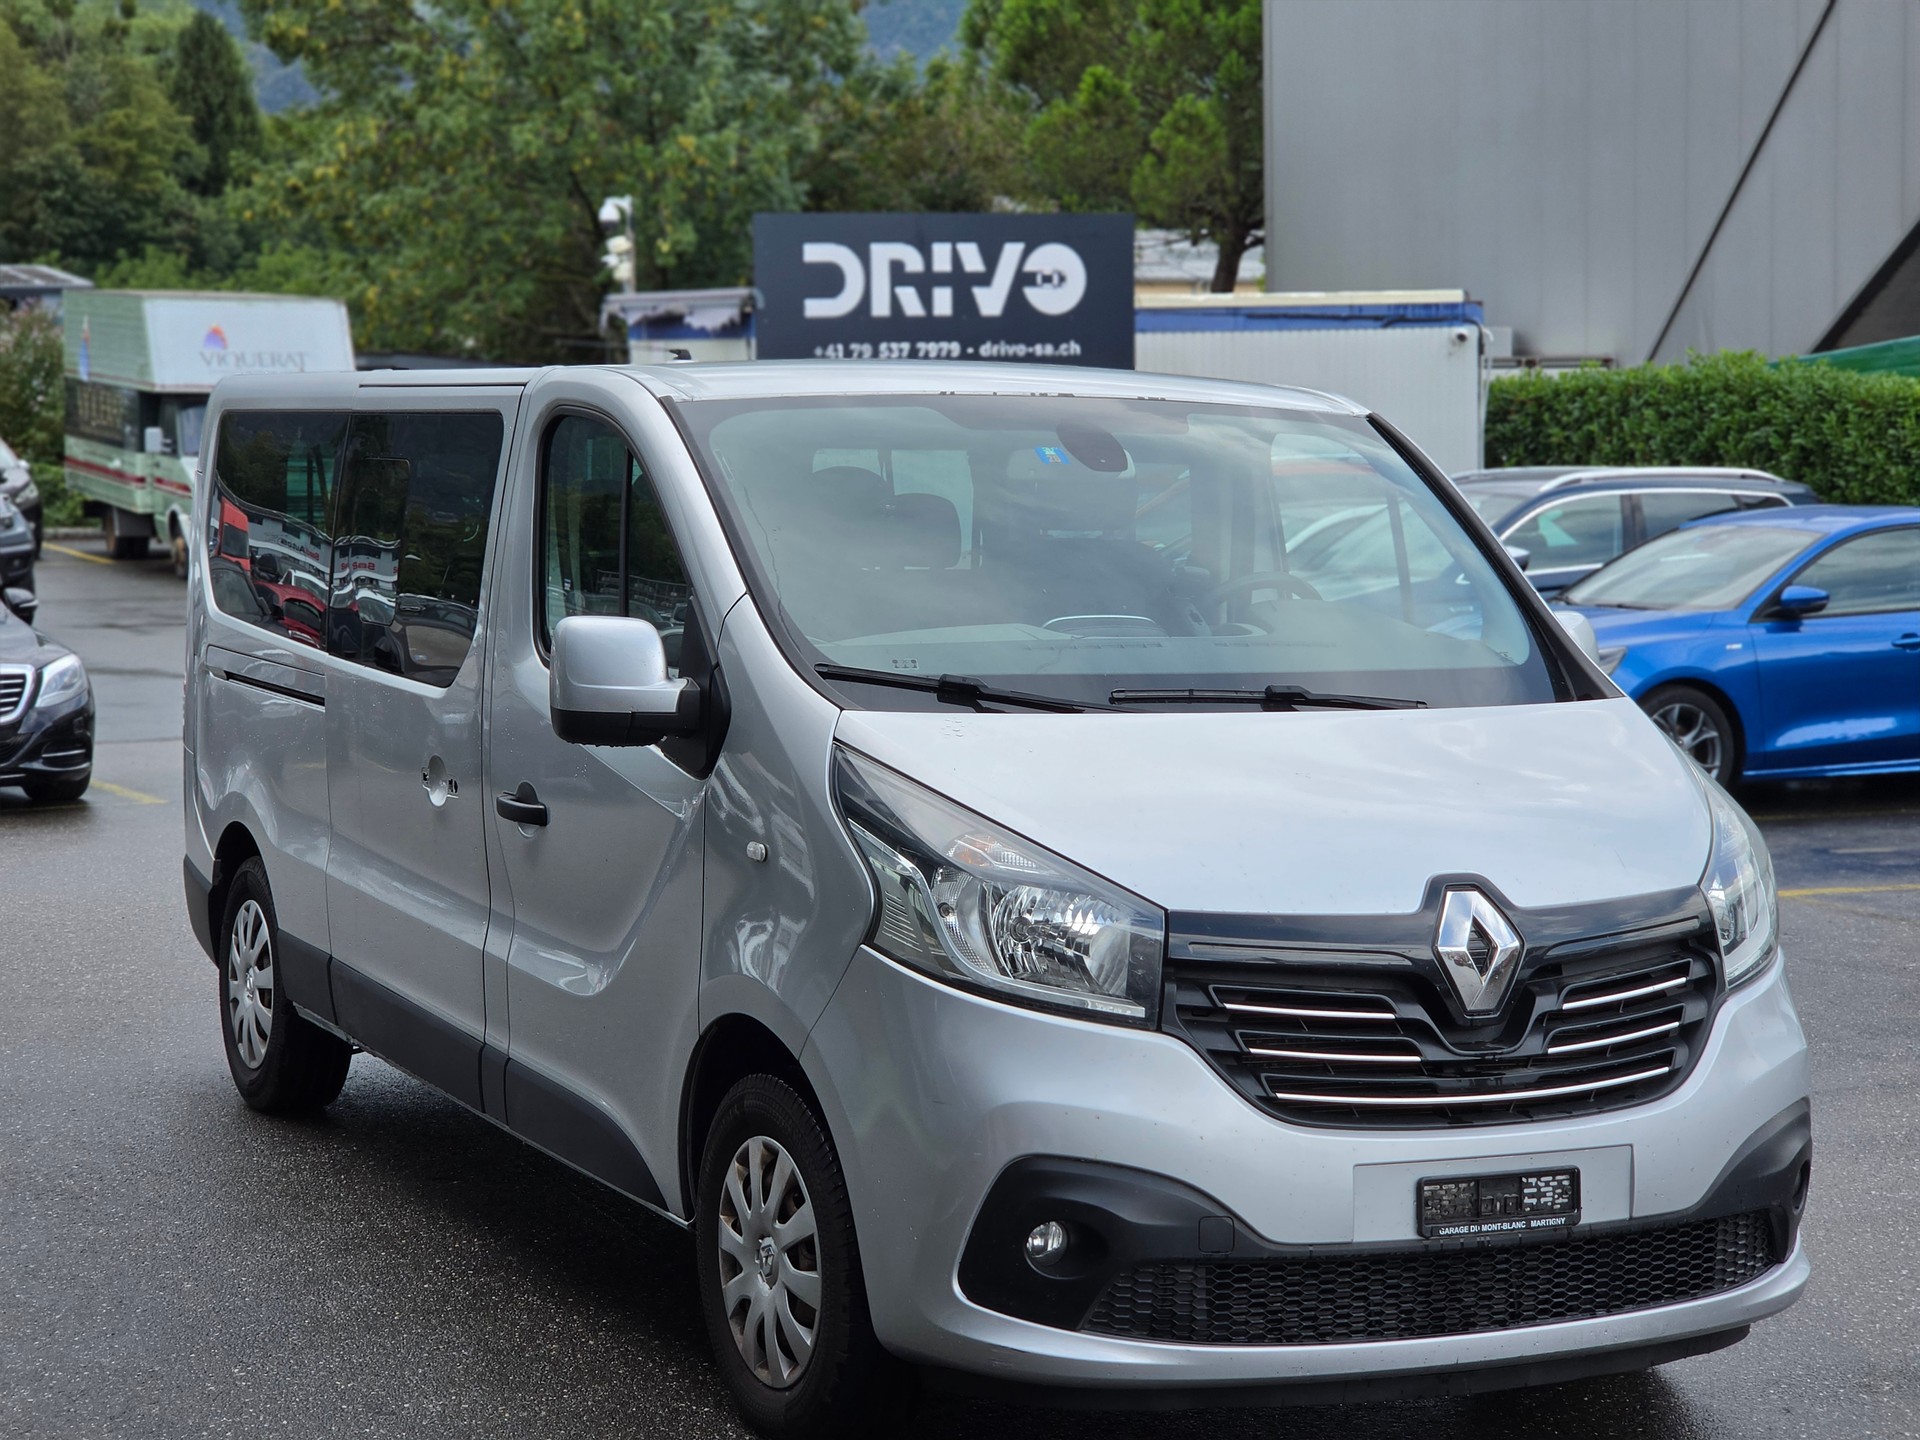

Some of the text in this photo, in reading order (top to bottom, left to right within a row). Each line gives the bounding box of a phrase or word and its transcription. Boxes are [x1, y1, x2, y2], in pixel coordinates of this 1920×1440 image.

[803, 242, 1087, 318] DRIVO
[814, 340, 1082, 359] +41 79 537 7979 drivo-sa.ch
[1439, 1226, 1469, 1235] GARAGE
[1481, 1220, 1526, 1232] MONT-BLANC
[1530, 1217, 1566, 1228] MARTIGNY
